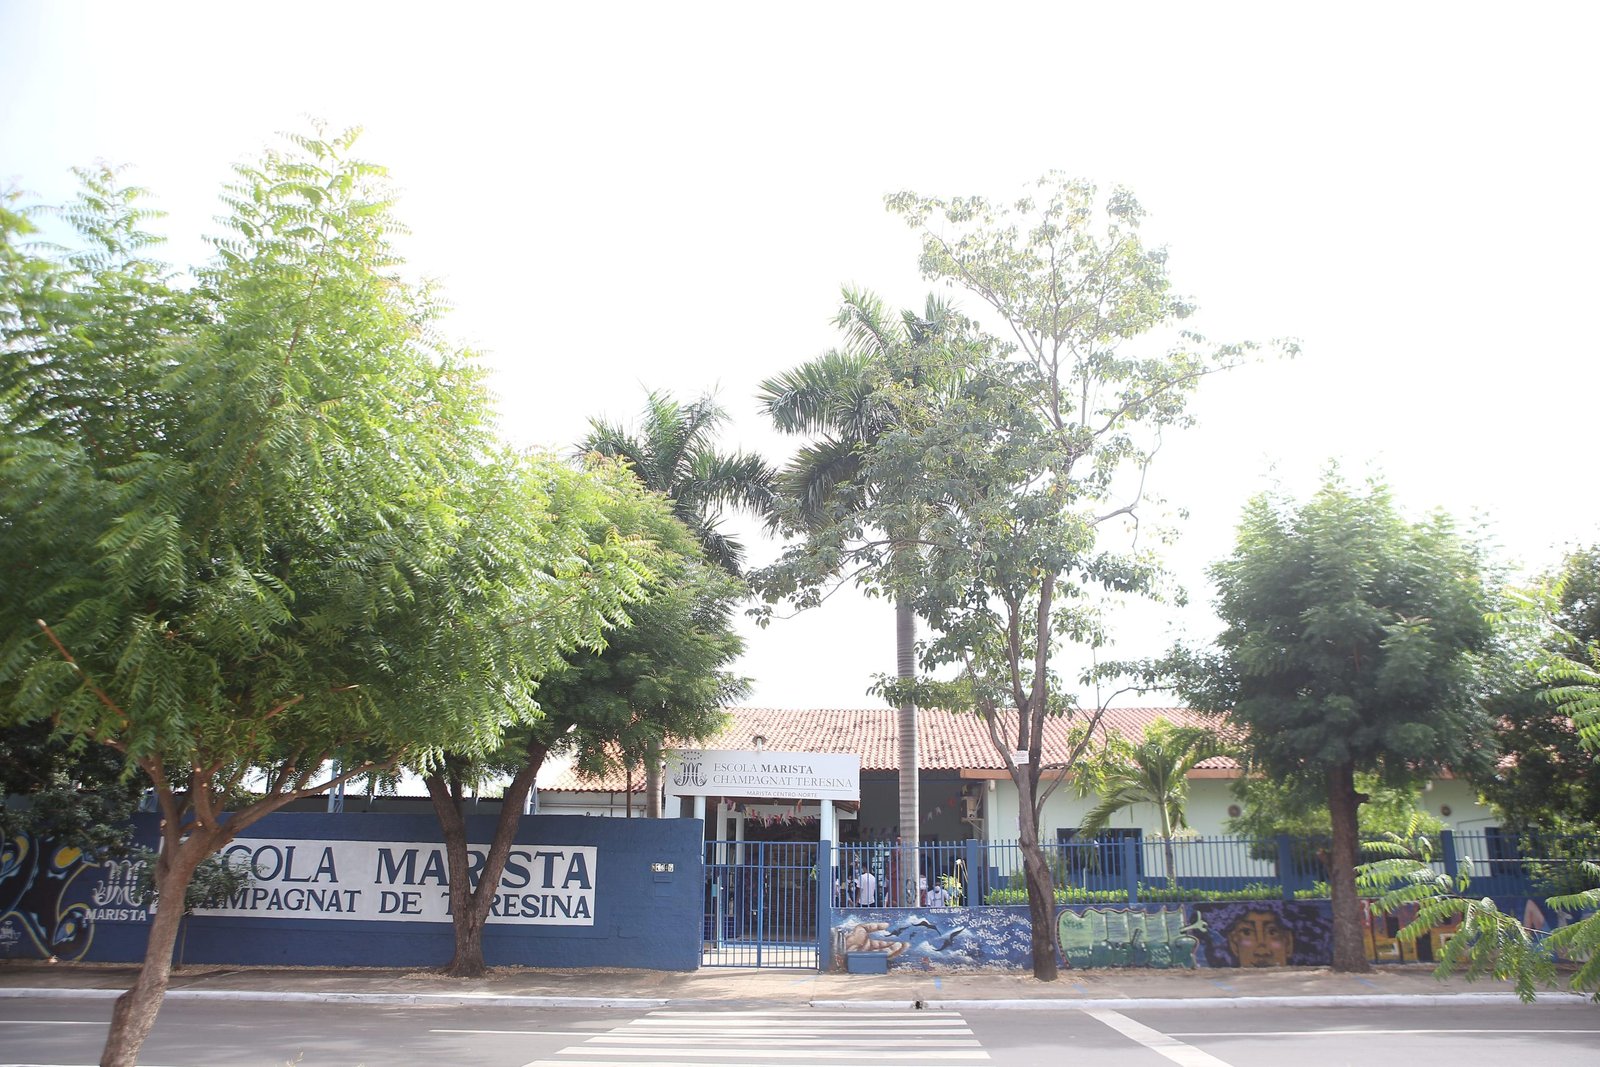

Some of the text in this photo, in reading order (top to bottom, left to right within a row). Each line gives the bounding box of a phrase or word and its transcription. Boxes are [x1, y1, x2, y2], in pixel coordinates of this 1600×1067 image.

[713, 762, 814, 775] ESCOLA MARISTA
[713, 774, 853, 788] CHAMPAGNAT TERESINA
[374, 847, 593, 890] MARSTA
[378, 890, 423, 915] DE
[84, 908, 147, 922] MARISTA
